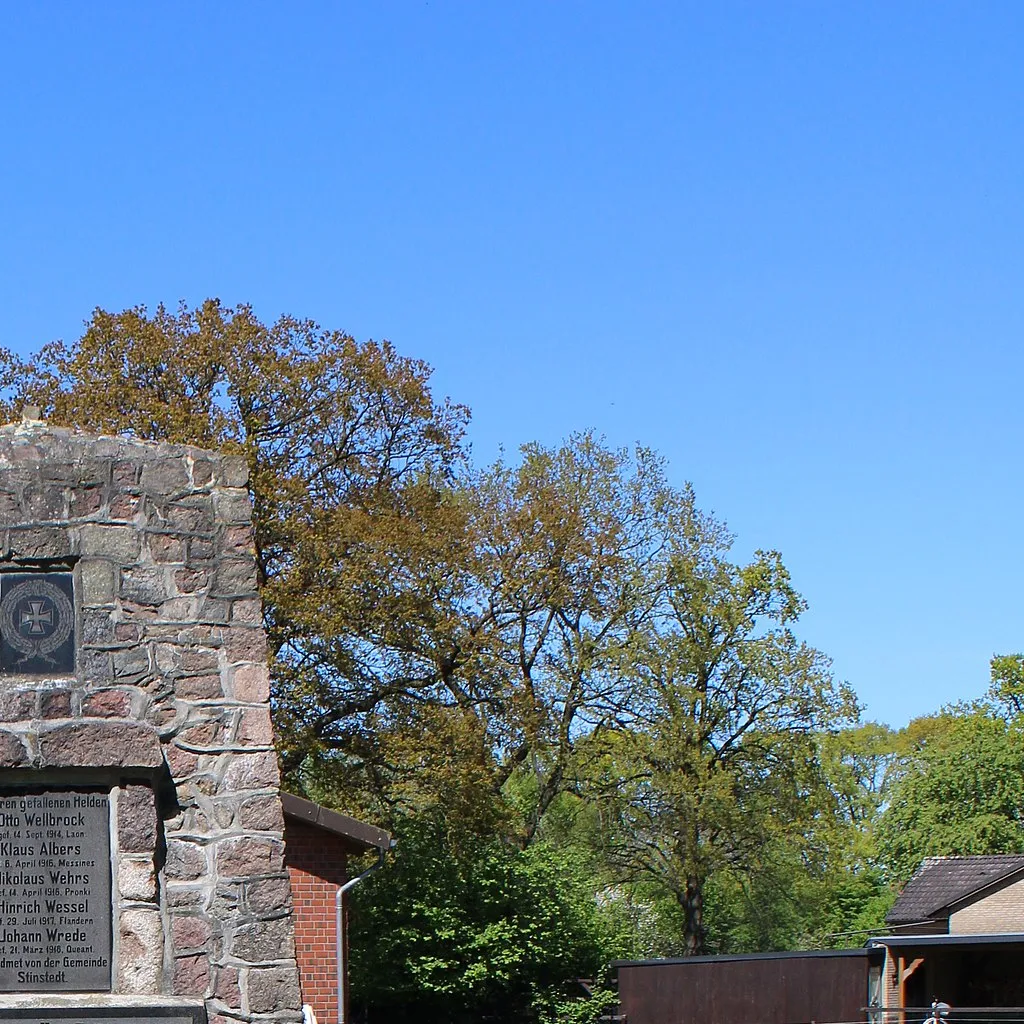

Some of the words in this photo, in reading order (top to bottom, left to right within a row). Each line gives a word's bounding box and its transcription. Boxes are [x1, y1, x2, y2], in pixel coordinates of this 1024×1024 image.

[20, 797, 70, 812] gefallenen
[73, 796, 107, 808] Helden
[25, 812, 85, 826] Wellbrock
[0, 842, 34, 856] Klaus
[40, 842, 81, 855] Albers
[16, 860, 36, 869] April
[58, 859, 95, 867] Messines
[49, 871, 89, 884] Wehrs
[22, 889, 42, 897] April
[45, 899, 88, 913] Wessel
[7, 918, 19, 926] 29.
[59, 917, 94, 925] Flandern
[46, 928, 86, 941] Wrede
[23, 946, 43, 954] März
[25, 959, 41, 968] von
[44, 957, 60, 968] der
[63, 957, 107, 967] Gemeinde
